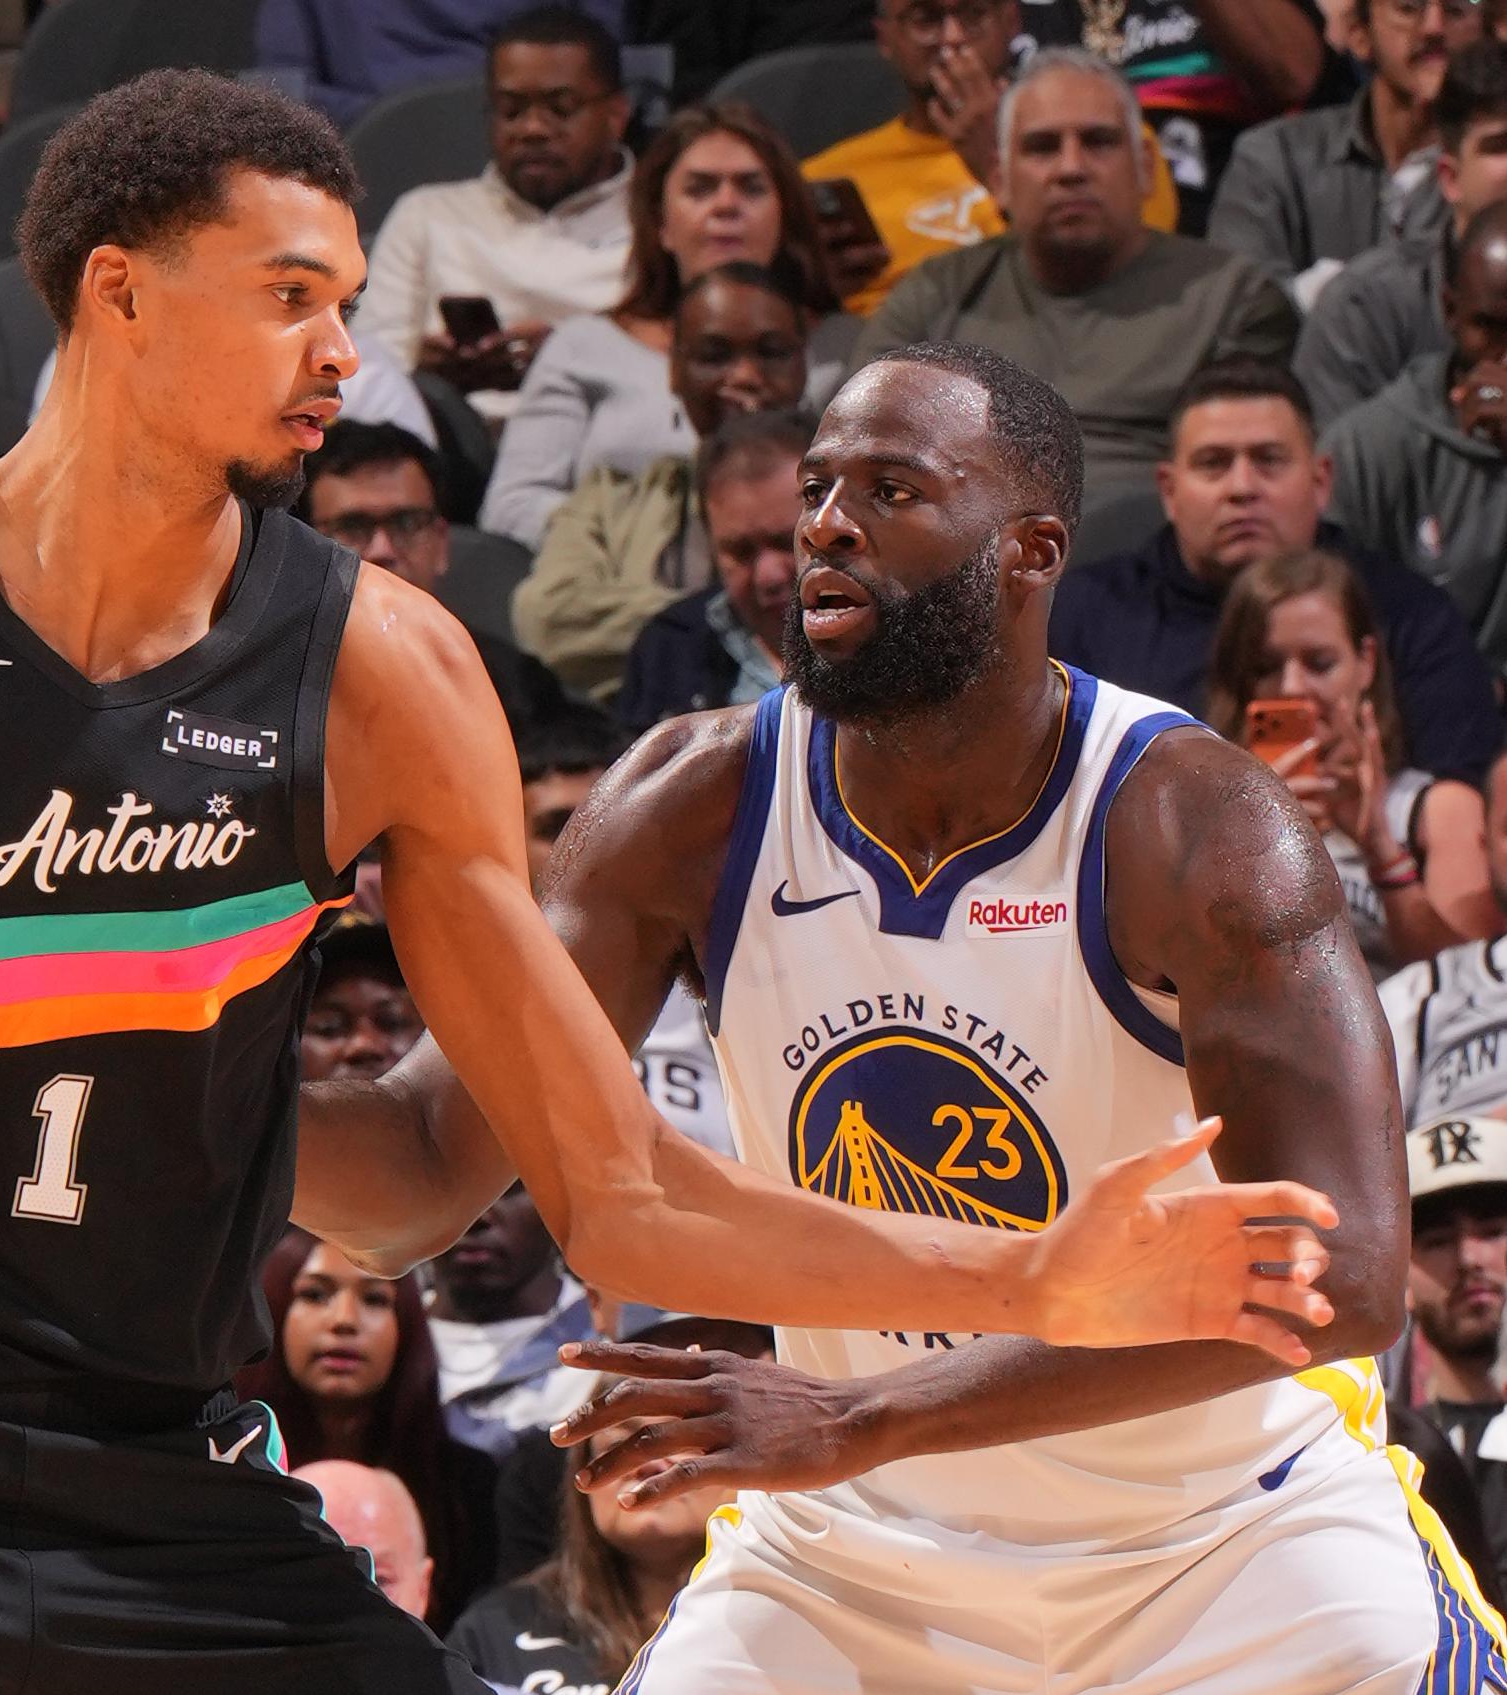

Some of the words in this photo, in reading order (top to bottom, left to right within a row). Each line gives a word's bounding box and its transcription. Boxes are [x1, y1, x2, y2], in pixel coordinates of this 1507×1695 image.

[177, 725, 262, 757] LEDGER
[969, 898, 1067, 925] Rakuten
[783, 993, 924, 1071] GOLDEN
[942, 1005, 1049, 1094] STATE
[10, 1072, 95, 1227] 1
[931, 1103, 1023, 1181] 23
